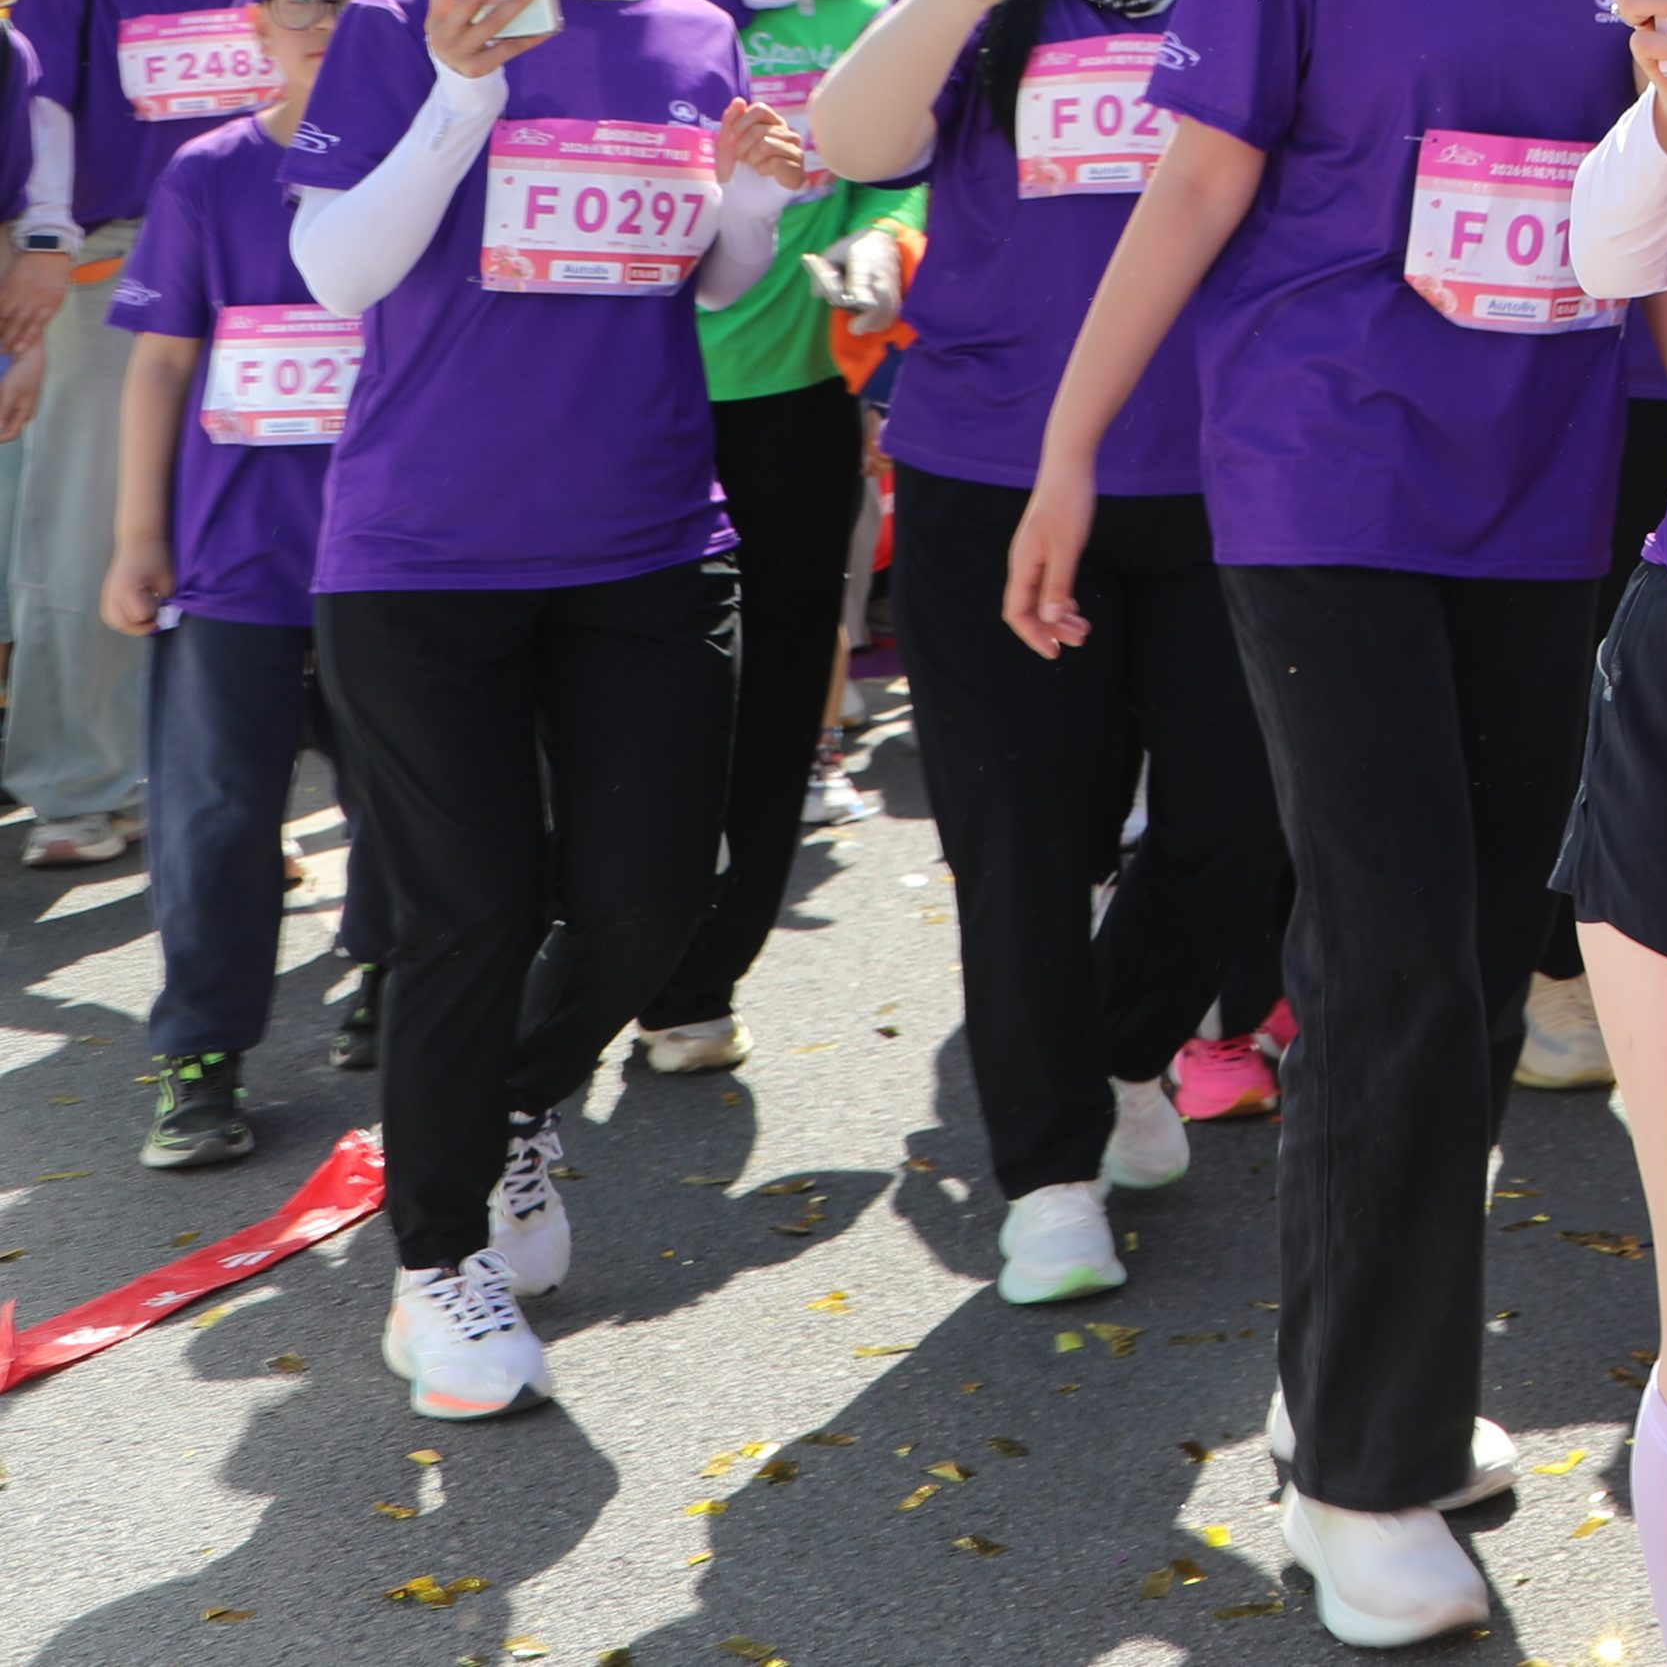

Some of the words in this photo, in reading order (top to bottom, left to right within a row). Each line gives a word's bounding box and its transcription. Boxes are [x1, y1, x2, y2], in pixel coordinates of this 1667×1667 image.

[1051, 94, 1181, 140] F02
[523, 185, 707, 238] F0297
[235, 357, 362, 397] F02
